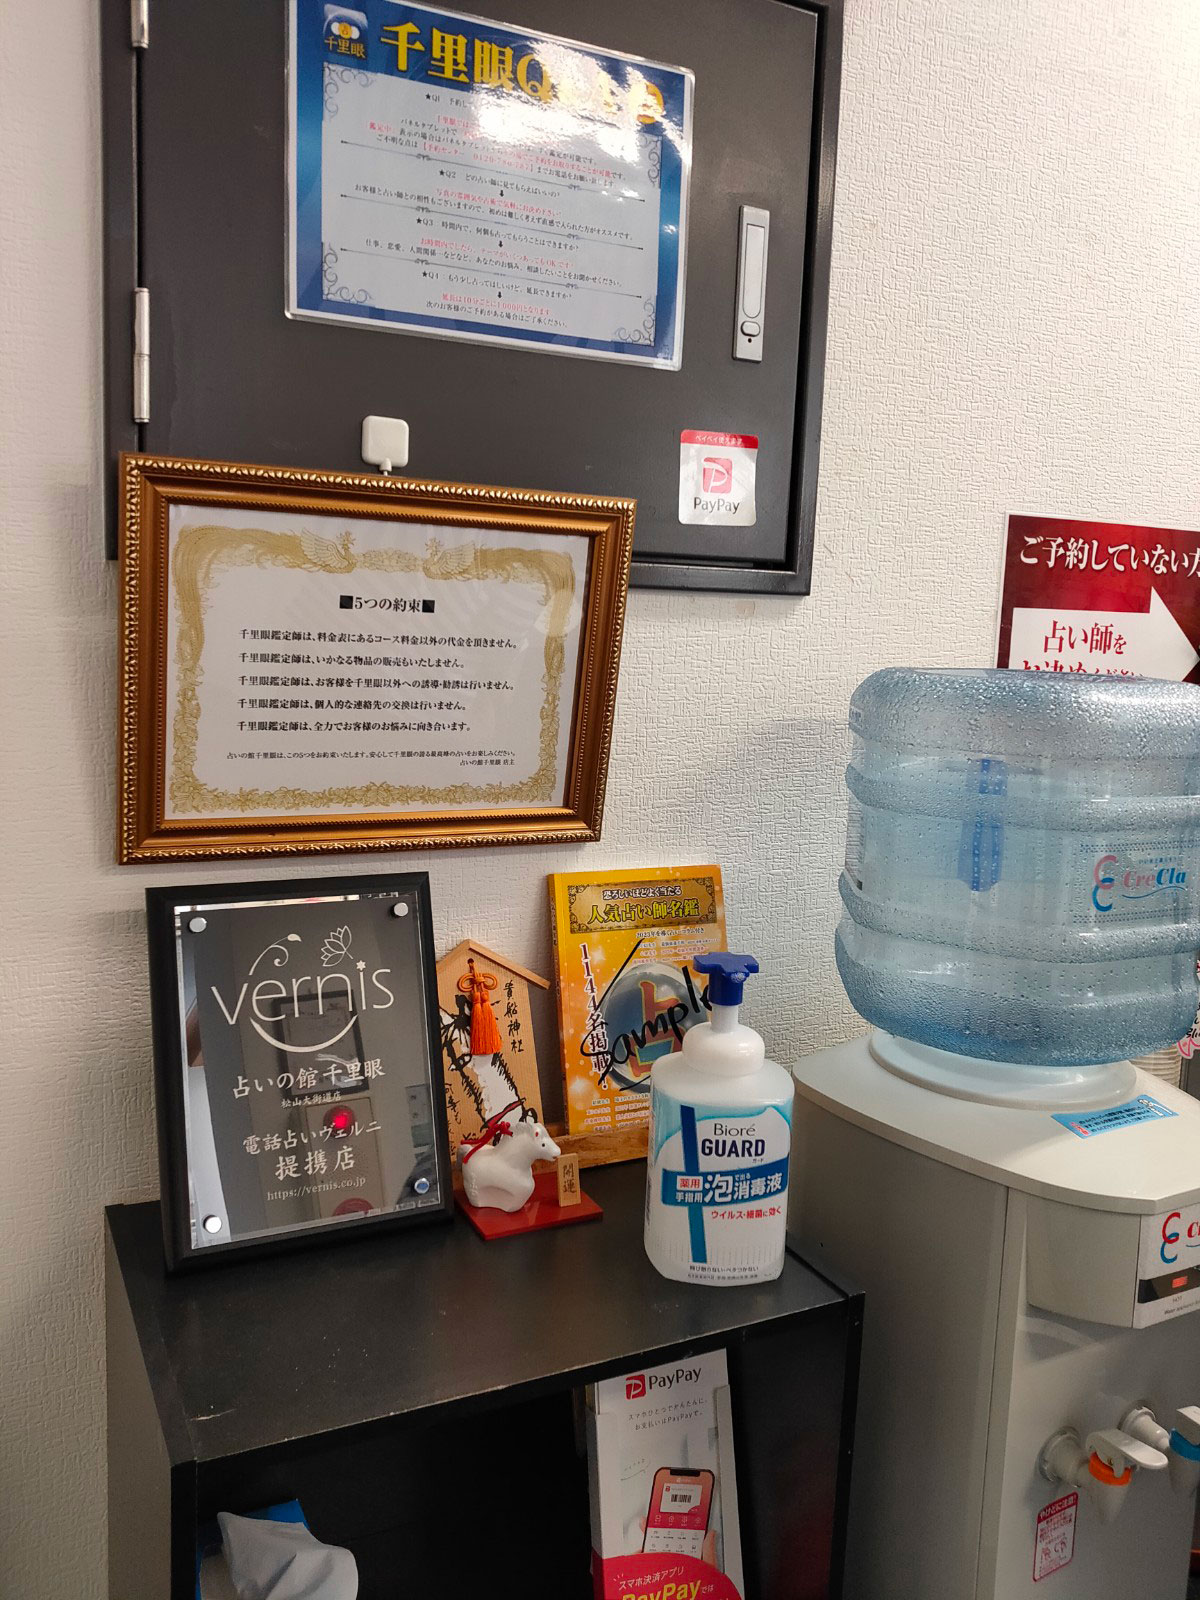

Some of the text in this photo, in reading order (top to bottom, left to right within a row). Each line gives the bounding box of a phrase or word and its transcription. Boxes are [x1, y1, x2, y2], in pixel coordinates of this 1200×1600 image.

[323, 36, 366, 59] 千里眼
[693, 496, 740, 515] PayPay
[239, 628, 518, 649] 千里眼鑑定師は、料金表にあるコース料金以外の代金を頂きません。
[1043, 620, 1128, 656] 占い師を
[238, 652, 465, 668] 千里眼鑑定師は、いかなる物品の販売もいたしません。
[237, 675, 514, 690] 千里眼鑑定師は、お客様を千里眼以外への誘導・勧誘は行いません。
[237, 698, 467, 711] 千里眼鑑定師は、個人的な連絡先の交換は行いません。
[236, 720, 471, 732] 千里眼鑑定師は、全力でお客様のお悩みに向き合います。
[1123, 867, 1187, 889] CreCla
[602, 885, 683, 900] 恐ろしいほどよく当たる
[586, 898, 700, 925] 人気占い師名鑑
[210, 959, 395, 1026] vernis
[503, 979, 525, 1054] 貴船神社
[280, 1091, 342, 1109] 松山大街道店
[242, 1120, 382, 1155] 電話占いヴェルニ
[713, 1122, 756, 1137] Bioré
[701, 1138, 766, 1158] GUARD
[274, 1145, 355, 1181] 提携店
[266, 1176, 366, 1201] https://vernis.co.jp
[561, 1162, 578, 1195] 開運
[679, 1177, 700, 1189] 薬用
[711, 1206, 782, 1220] ウイルス・細菌に効く
[648, 1367, 702, 1391] PayPay
[618, 1566, 684, 1591] スマホ決済アプリ
